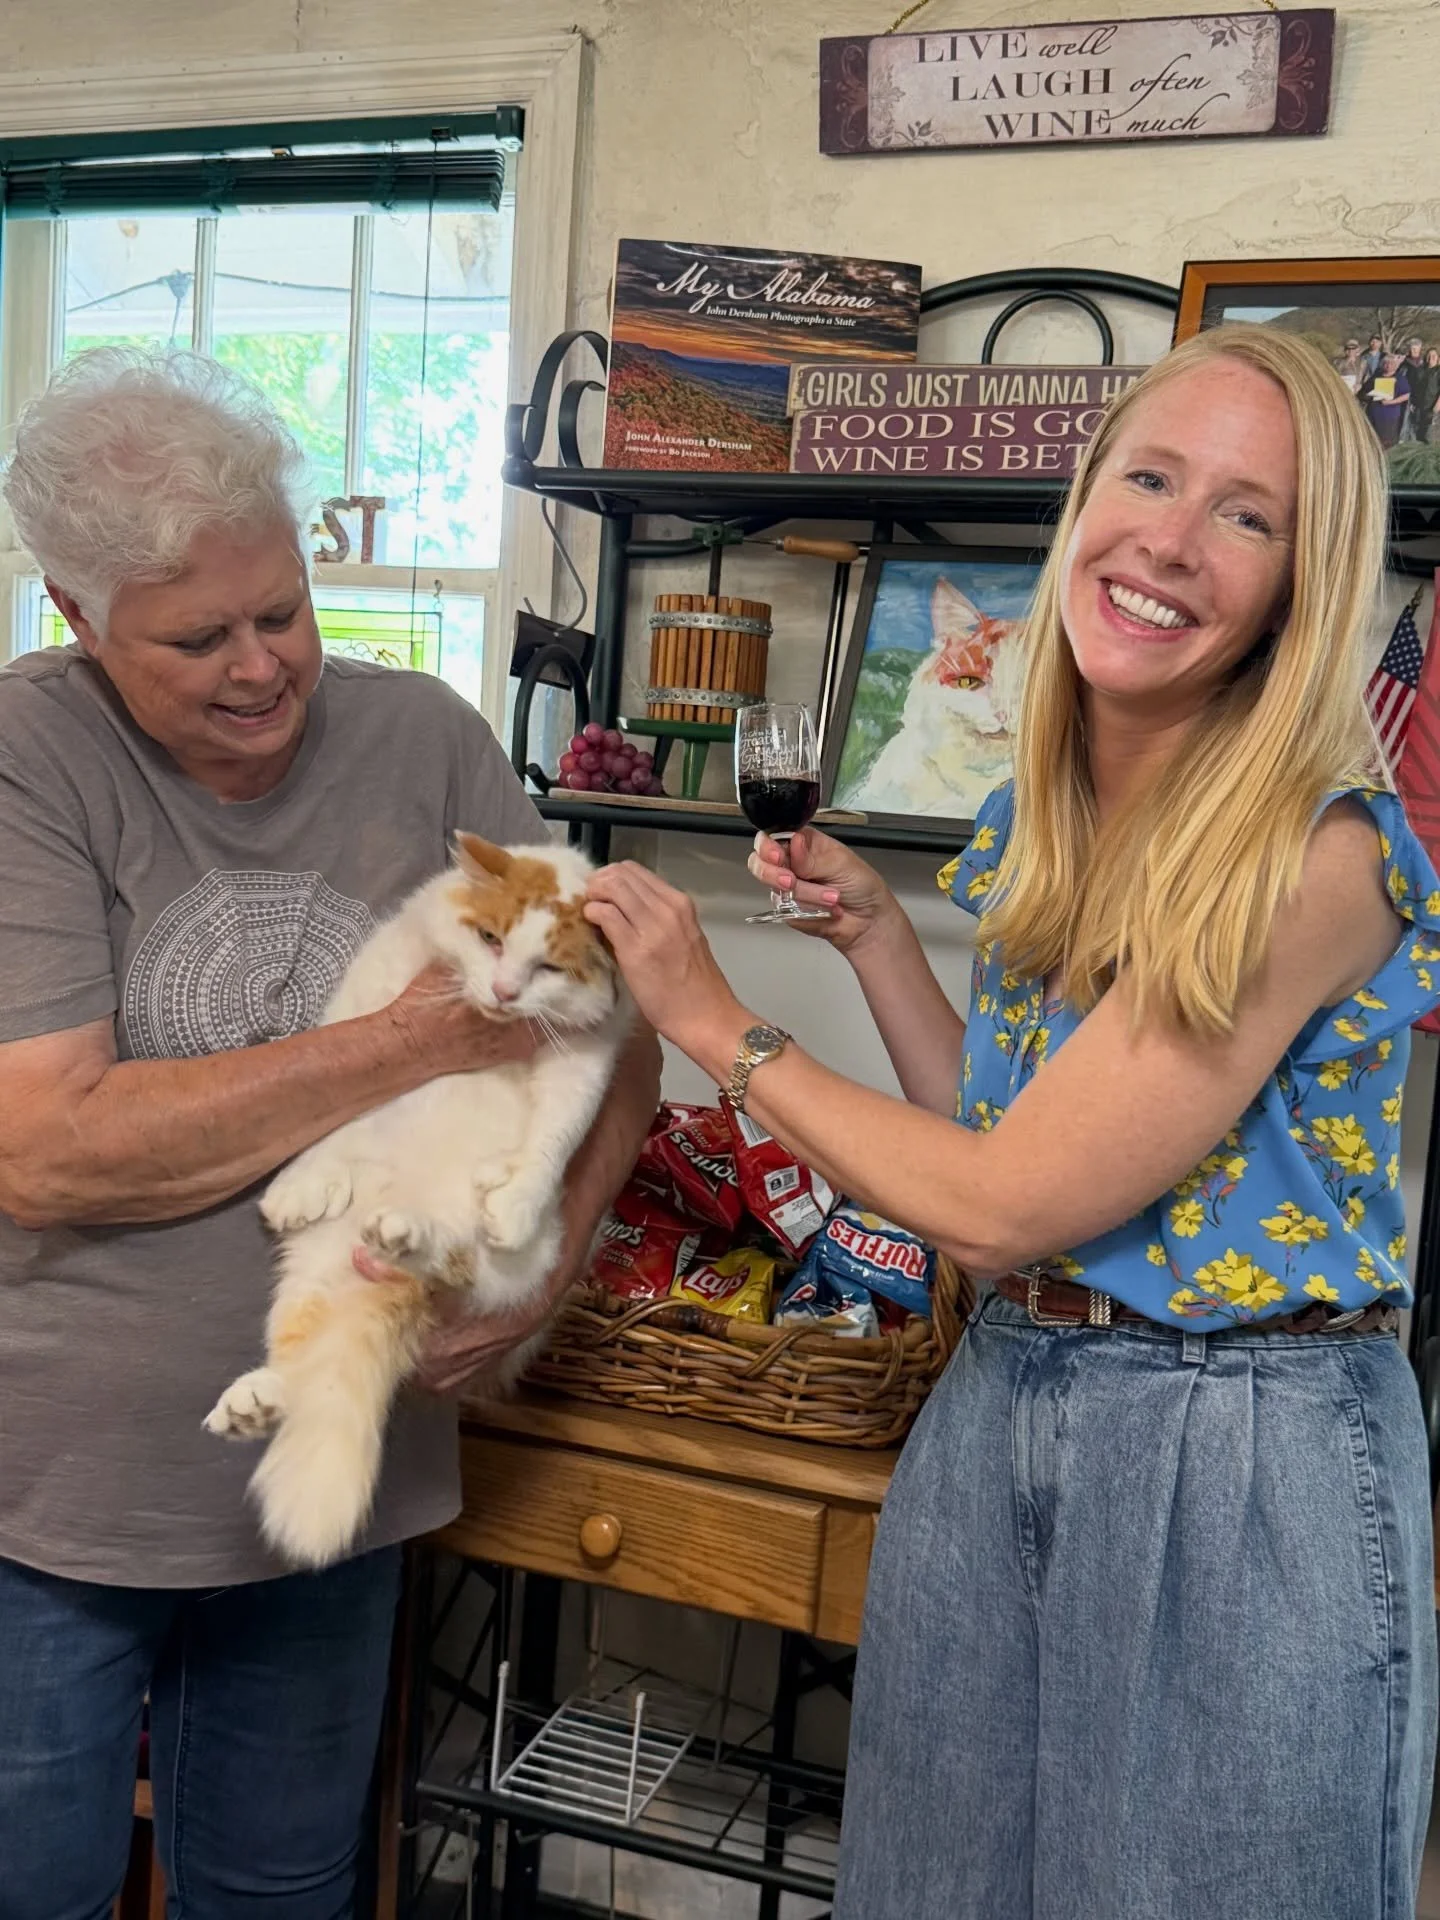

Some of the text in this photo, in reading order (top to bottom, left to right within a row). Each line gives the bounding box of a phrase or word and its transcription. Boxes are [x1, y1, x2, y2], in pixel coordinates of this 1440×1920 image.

[915, 25, 1118, 63] LIVE well
[951, 54, 1211, 108] LAUGH often
[983, 94, 1231, 139] WINE much
[656, 261, 876, 314] My Alabama
[706, 305, 727, 317] John
[728, 308, 768, 321] Dersham
[770, 311, 825, 327] Photographs
[834, 317, 857, 328] State
[807, 371, 888, 408] GIRLS
[896, 372, 970, 408] JUST
[979, 373, 1089, 406] WANNA
[626, 430, 752, 451] JOHN ALEXANDER DERSHAM
[810, 413, 954, 440] FOOD
[968, 411, 1016, 439] IS
[809, 446, 930, 472] WINE
[941, 445, 984, 471] IS
[827, 1218, 928, 1281] RUFFLES
